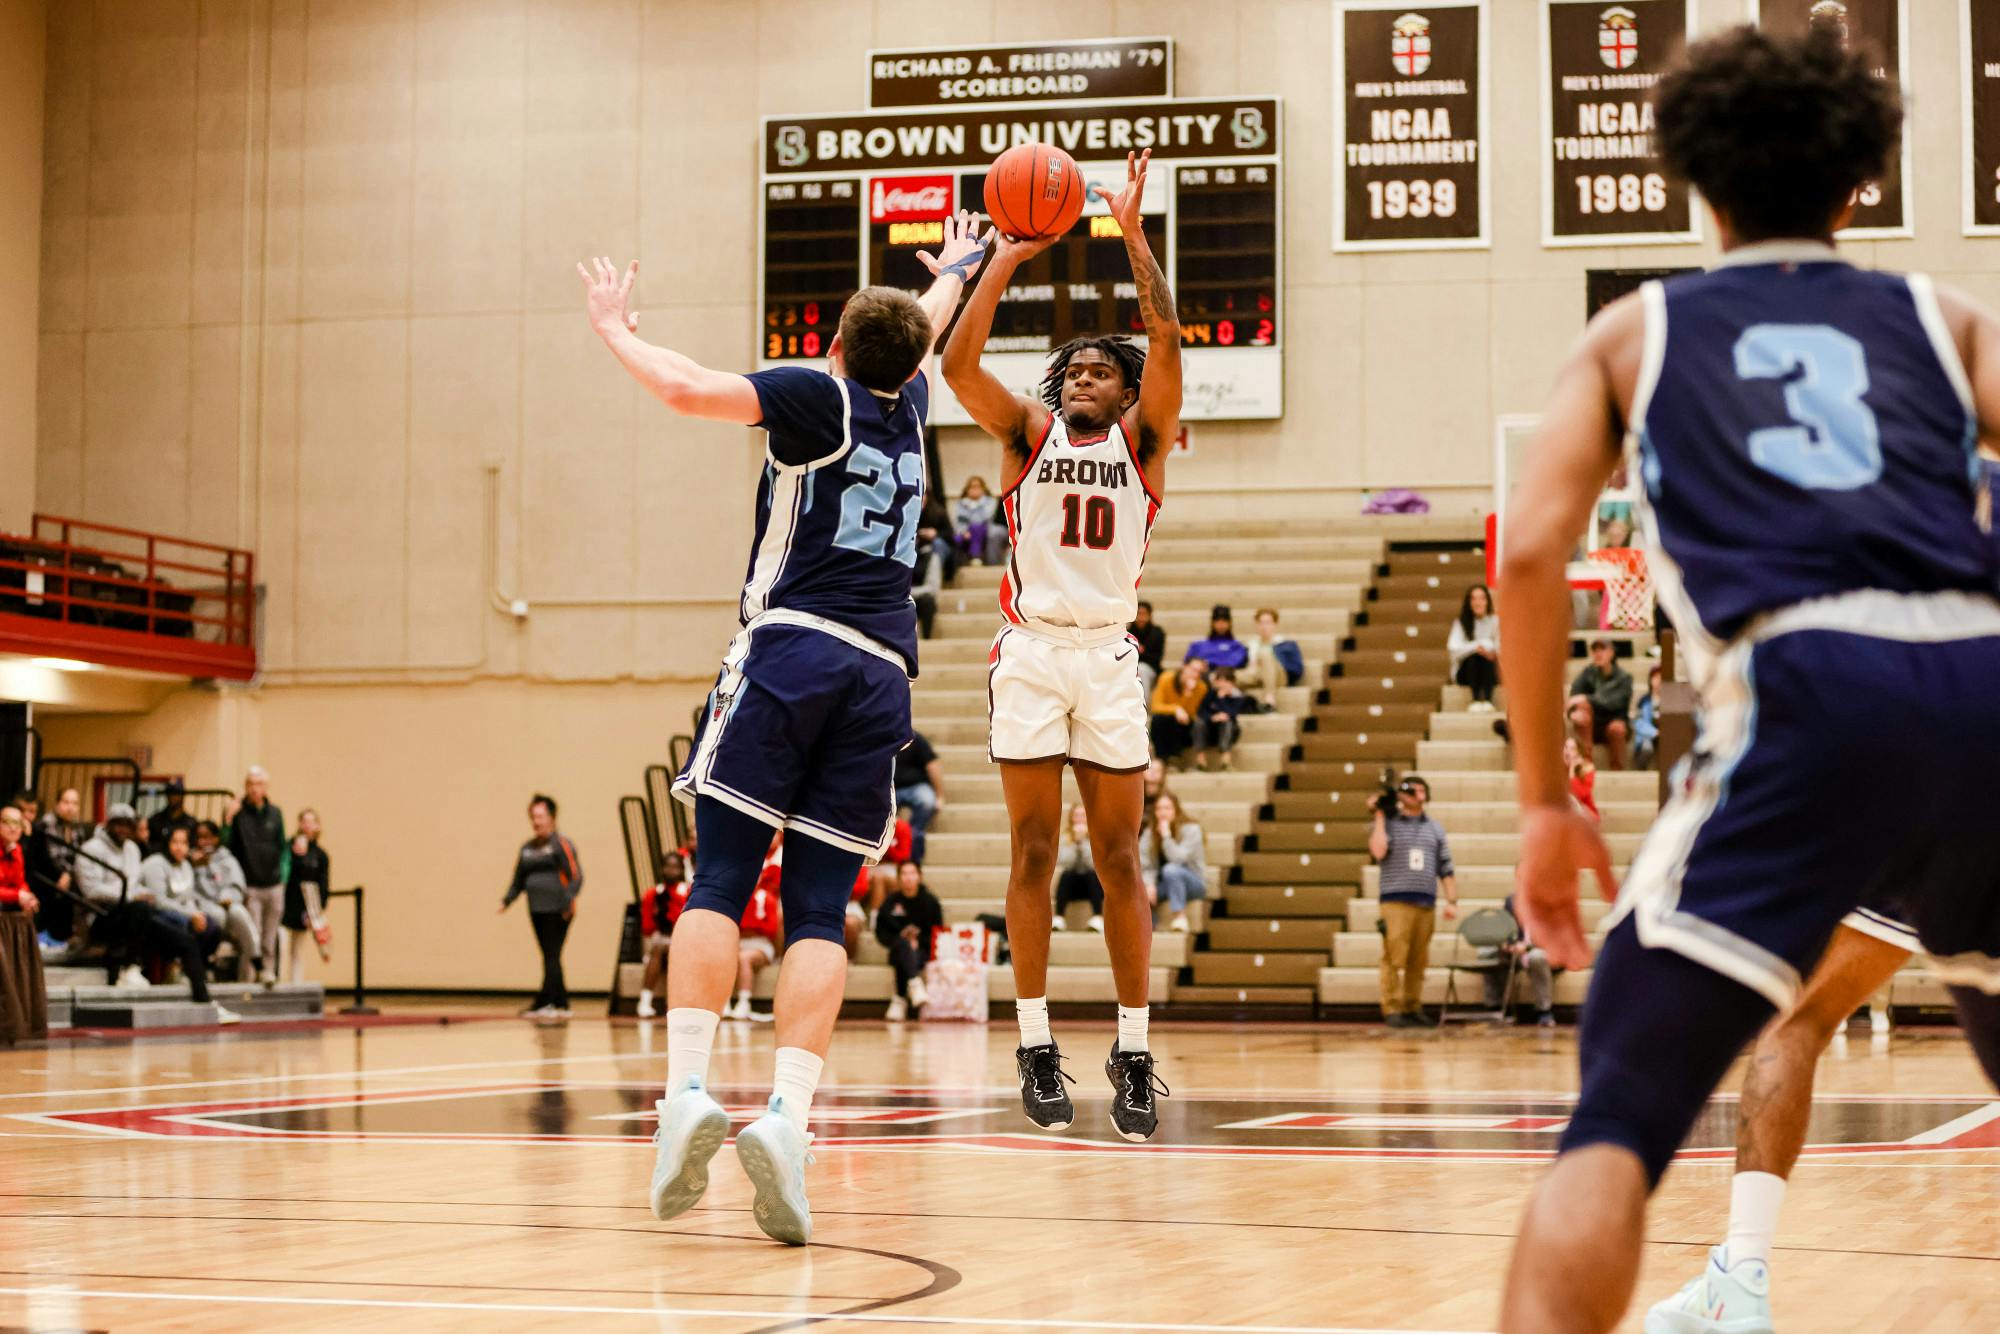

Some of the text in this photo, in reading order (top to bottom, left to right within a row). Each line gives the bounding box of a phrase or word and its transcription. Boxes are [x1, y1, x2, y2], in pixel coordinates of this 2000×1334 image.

[873, 57, 972, 79] RICHARD
[977, 55, 1002, 74] A.
[1008, 50, 1121, 72] FRIEDMAN
[938, 75, 1089, 98] SCOREBOARD
[1394, 80, 1467, 96] BASKETBALL
[1371, 107, 1451, 141] NCAA
[1578, 101, 1656, 135] NCAA
[816, 114, 1221, 160] BROWN UNIVERSITY
[1347, 139, 1477, 166] TOURNAMENT
[1554, 134, 1655, 160] TOURNAM
[1366, 179, 1457, 219] 1939
[1575, 173, 1666, 214] 1986
[1732, 322, 1884, 491] 3
[1037, 458, 1128, 489] BROWN
[831, 442, 922, 568] 22
[1060, 493, 1116, 551] 10
